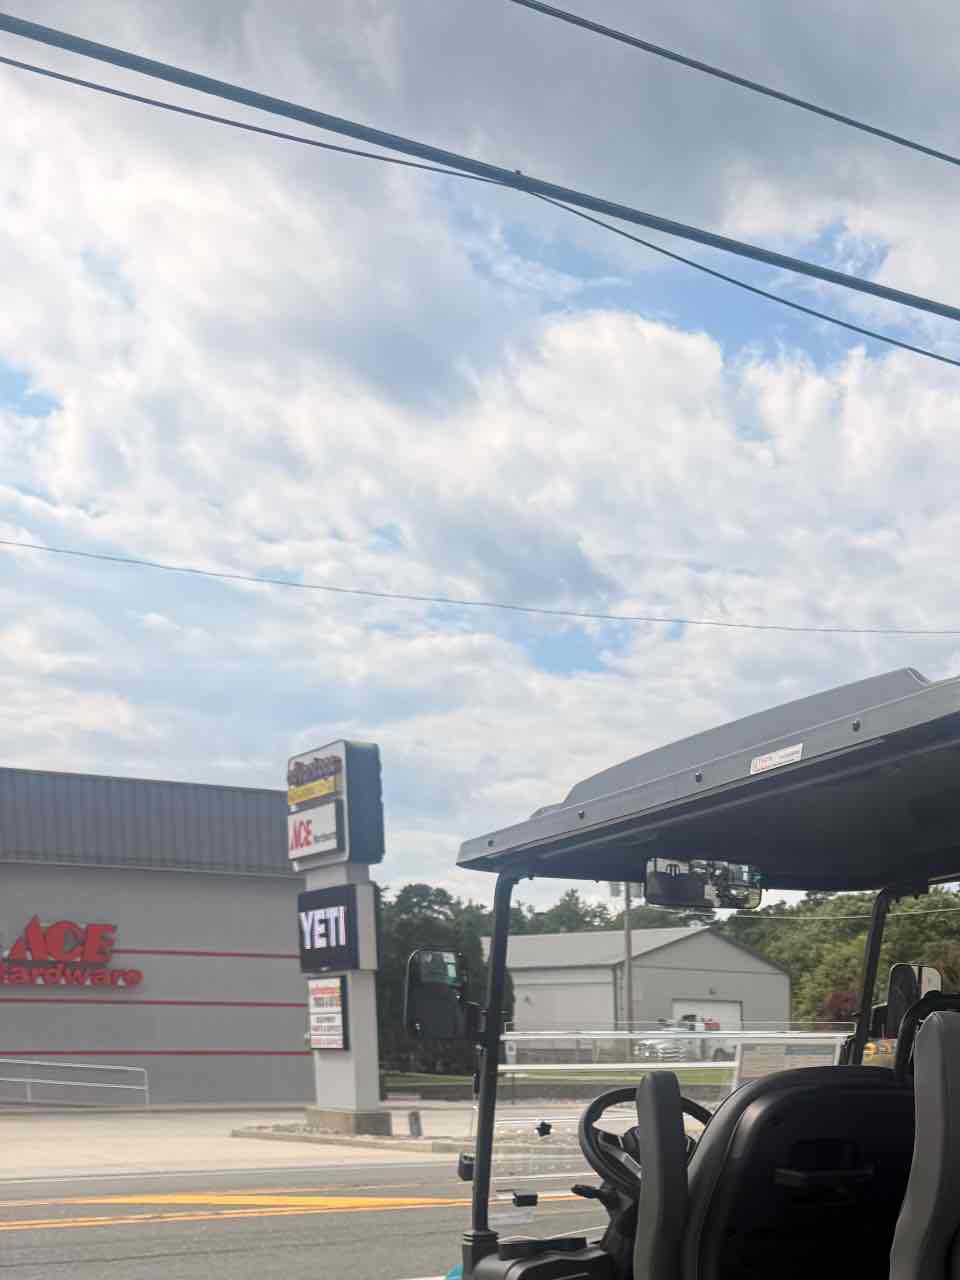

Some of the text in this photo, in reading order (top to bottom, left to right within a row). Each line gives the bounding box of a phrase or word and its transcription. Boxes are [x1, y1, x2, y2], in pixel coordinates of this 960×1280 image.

[291, 819, 312, 850] ACE
[8, 914, 117, 962] ACE
[300, 906, 346, 949] YETI
